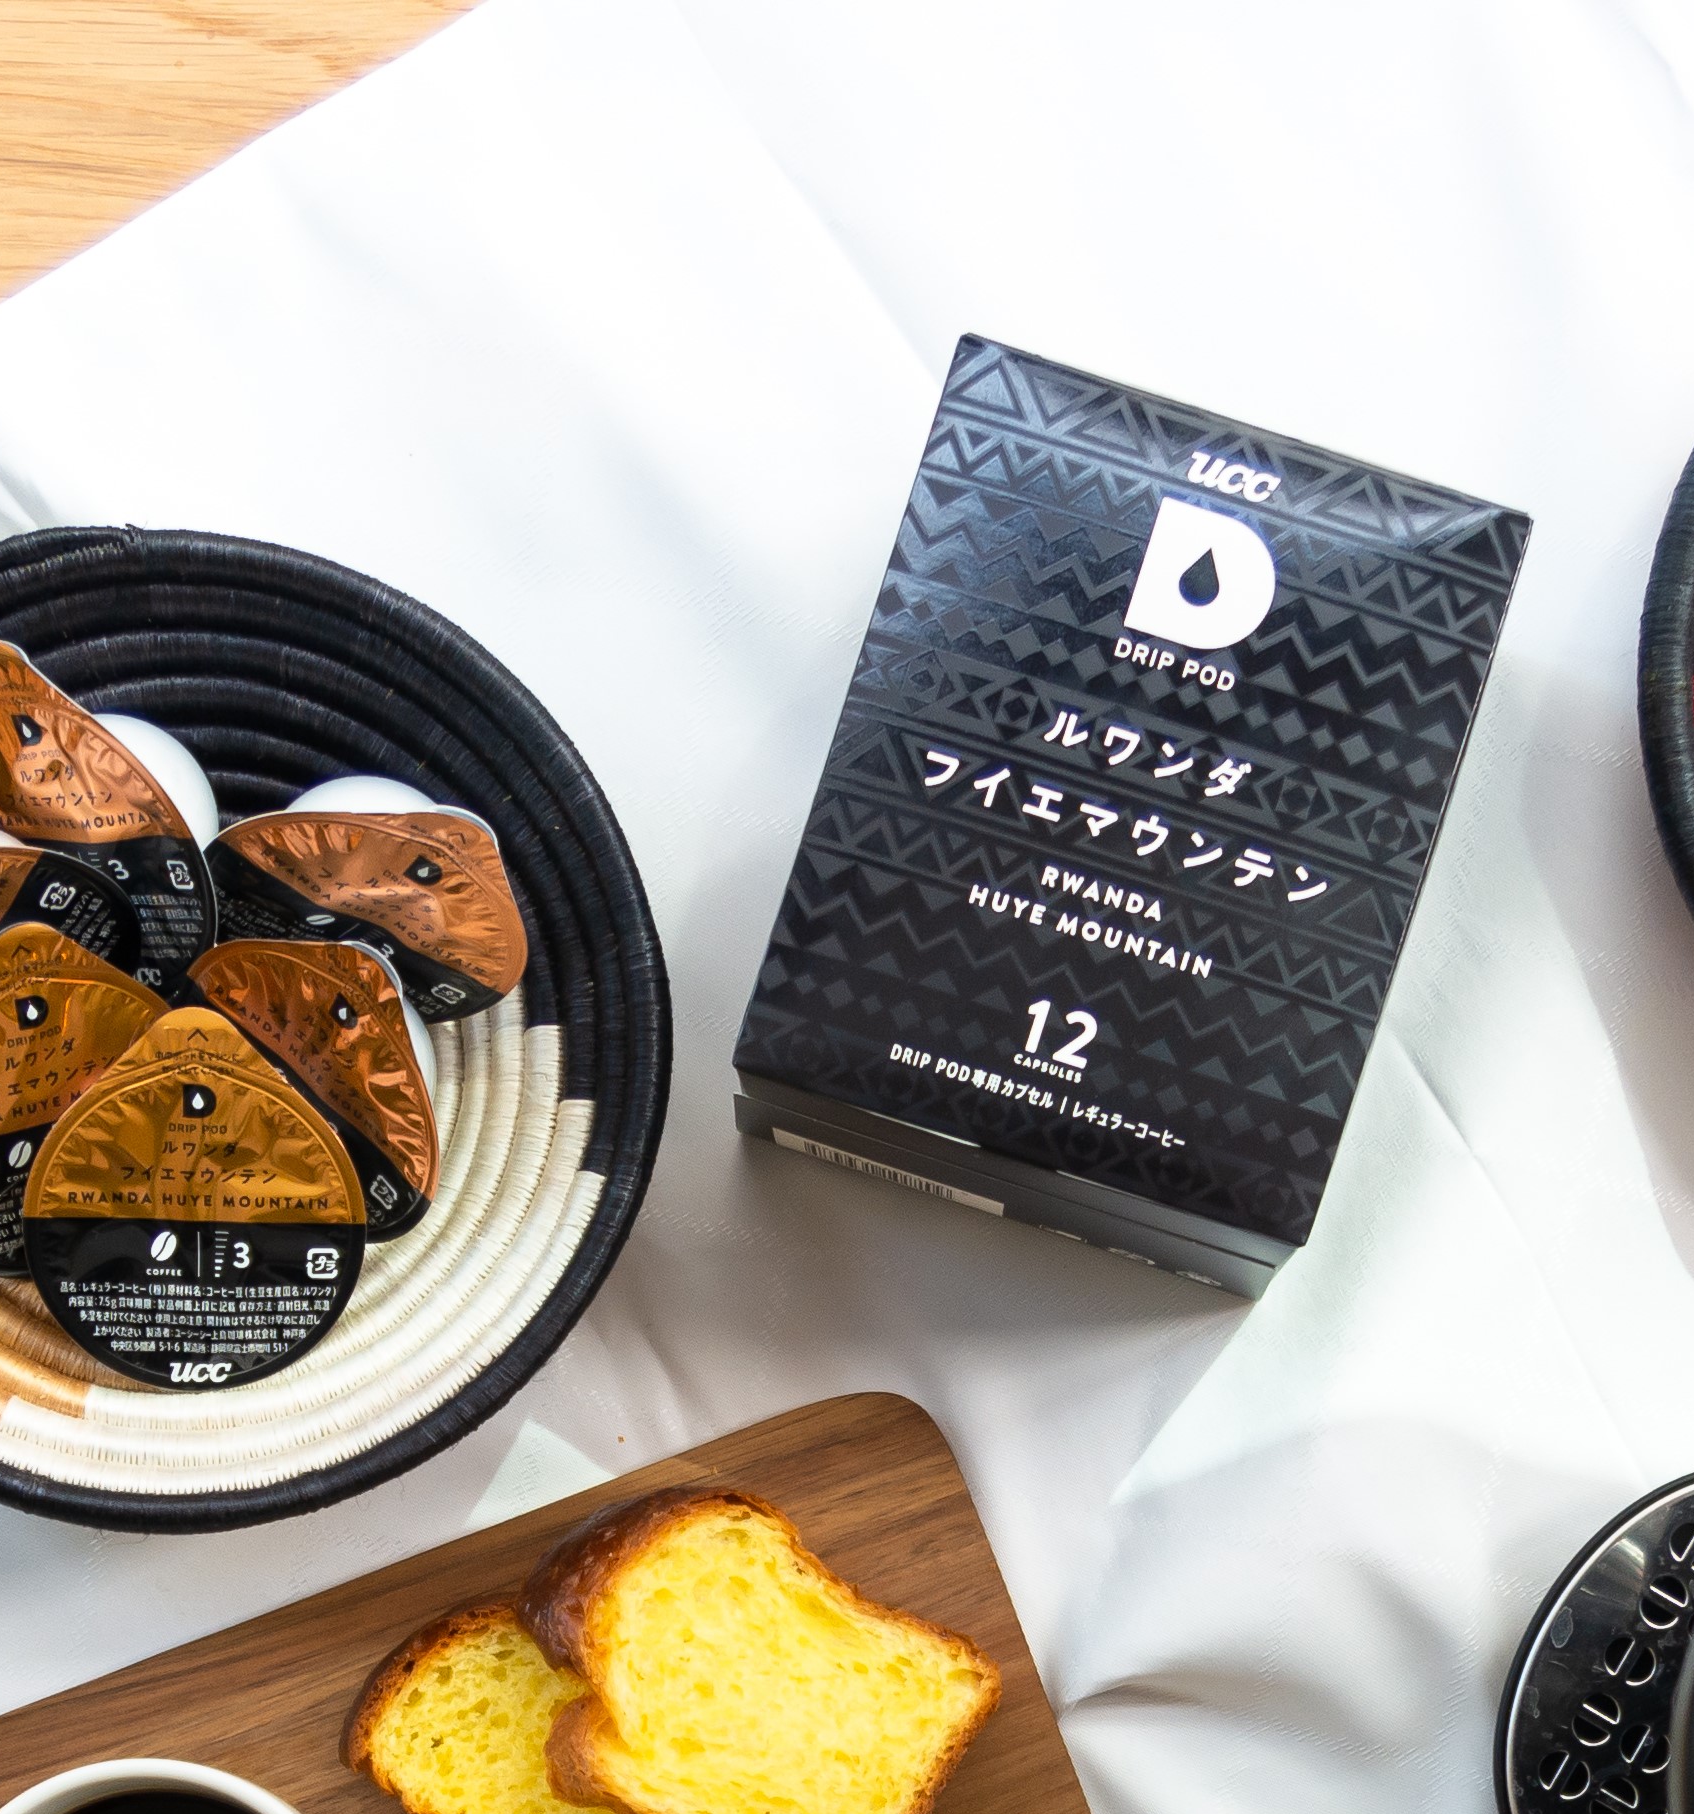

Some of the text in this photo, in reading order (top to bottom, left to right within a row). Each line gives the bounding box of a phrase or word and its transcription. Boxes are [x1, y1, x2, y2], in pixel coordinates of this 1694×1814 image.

[1114, 638, 1236, 692] DRIP POD
[1044, 711, 1251, 797] ルワンダ
[924, 751, 1328, 902] フイエマウンテン
[108, 859, 130, 881] 3
[1041, 865, 1163, 922] RWANDA
[968, 884, 1213, 979] HUYE MOUNTAIN
[7, 1026, 62, 1049] DRIP POD
[1024, 999, 1098, 1070] 12
[5, 1037, 76, 1072] ルワンダ
[1013, 1053, 1082, 1084] CAPSULES
[12, 1095, 61, 1118] HUYE
[890, 1043, 932, 1070] DRIP
[1072, 1101, 1187, 1148] レギュラーコーヒー
[168, 1122, 228, 1135] DRIP POD
[161, 1140, 237, 1158] ルワンダ
[121, 1166, 278, 1185] フイエマウンテン
[67, 1191, 329, 1210] RWANDA HUYE MOUNTAIN
[232, 1242, 250, 1269] 3
[146, 1268, 182, 1277] COFFEE
